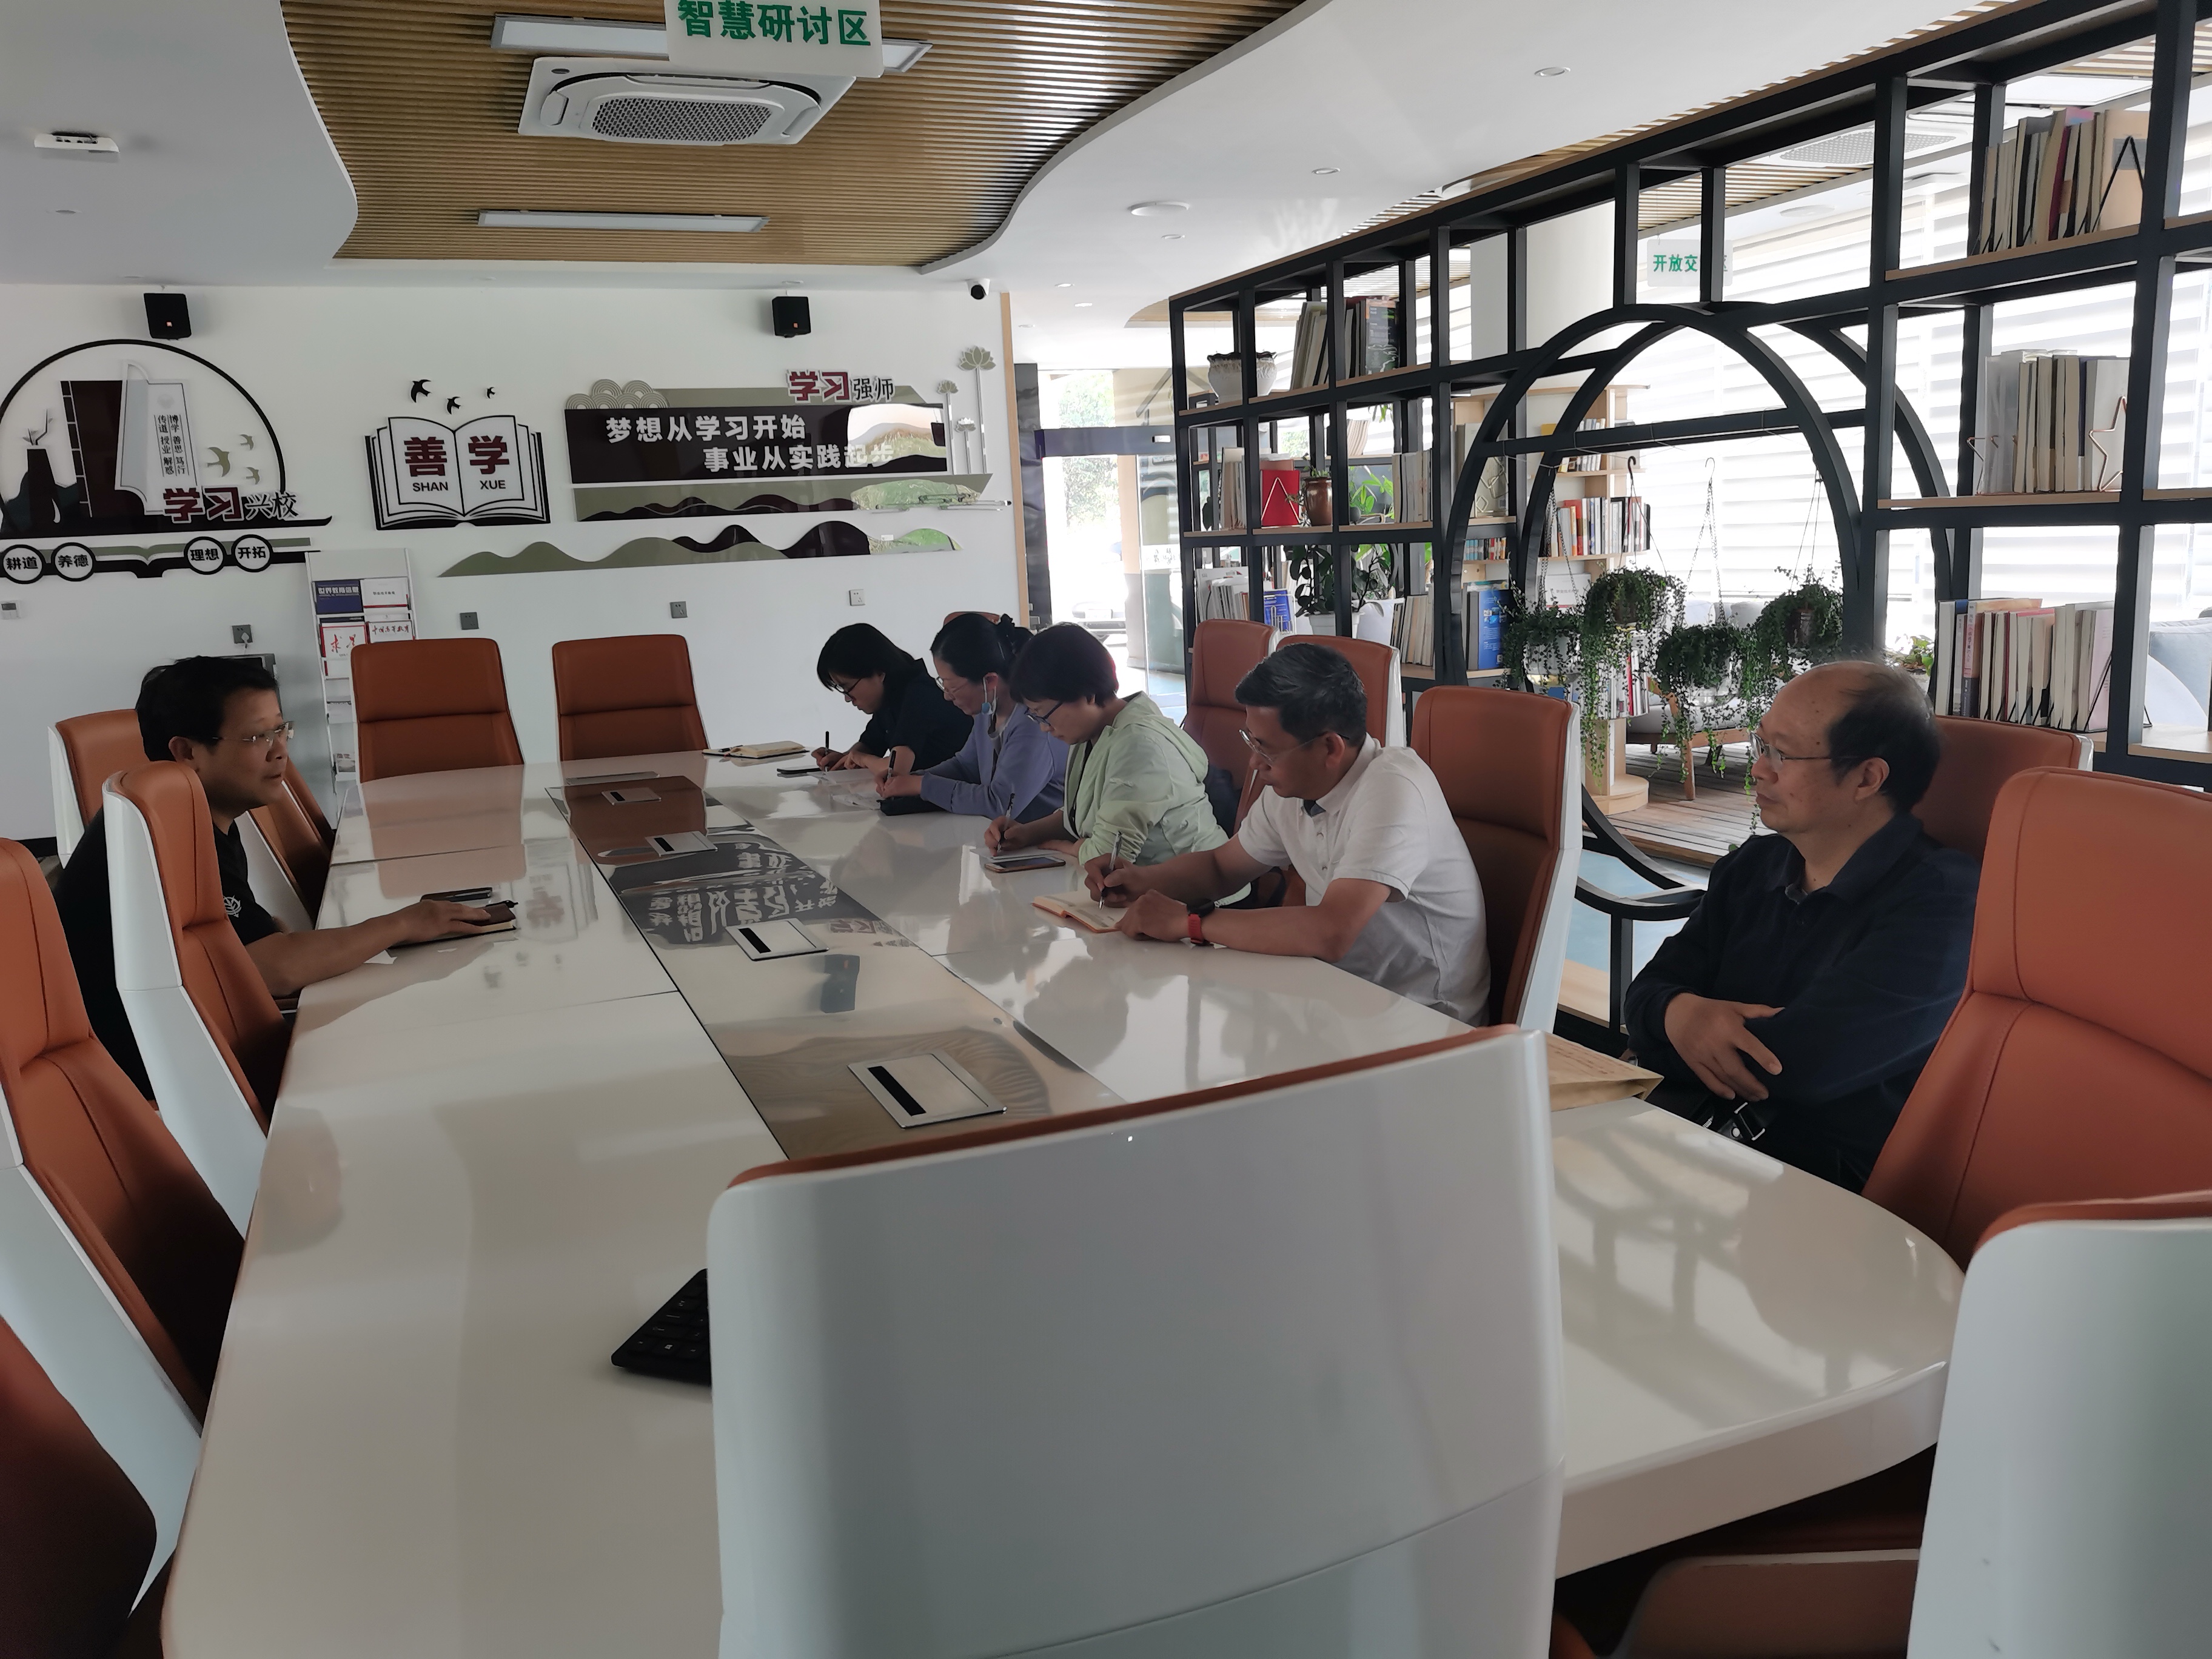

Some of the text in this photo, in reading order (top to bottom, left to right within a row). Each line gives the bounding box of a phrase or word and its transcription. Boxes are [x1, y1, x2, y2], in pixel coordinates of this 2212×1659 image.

[677, 0, 871, 45] 智慧研讨区
[1653, 254, 1728, 272] 开放交
[789, 371, 894, 401] 学习强师
[606, 414, 806, 443] 梦想从学习开始
[404, 435, 510, 477] 善 学
[703, 444, 894, 472] 事业从实践起步
[412, 480, 506, 492] SHAN XUE
[163, 487, 299, 521] 学习兴校
[5, 556, 38, 571] 耕道
[58, 554, 89, 568] 养德
[190, 548, 220, 561] 理想
[237, 546, 266, 559] 开拓
